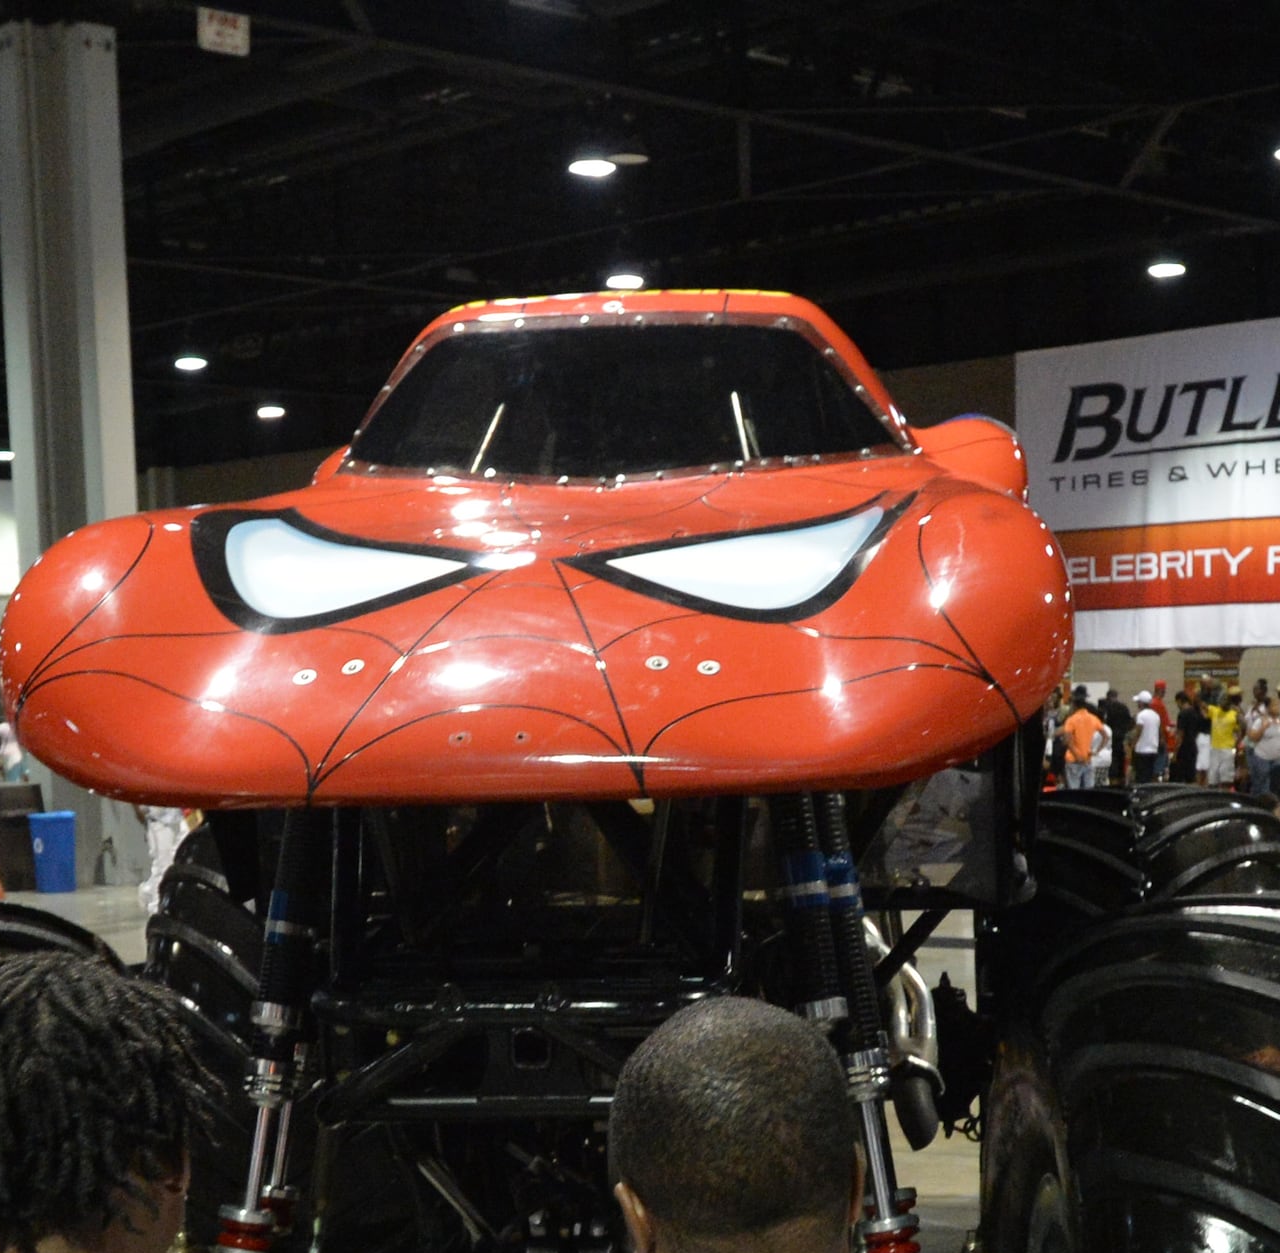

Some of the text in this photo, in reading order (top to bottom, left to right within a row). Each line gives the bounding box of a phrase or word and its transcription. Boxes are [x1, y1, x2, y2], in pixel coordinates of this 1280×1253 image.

[1048, 469, 1150, 494] TIRES
[1167, 465, 1189, 482] &
[1068, 546, 1254, 585] ELEBRITY
